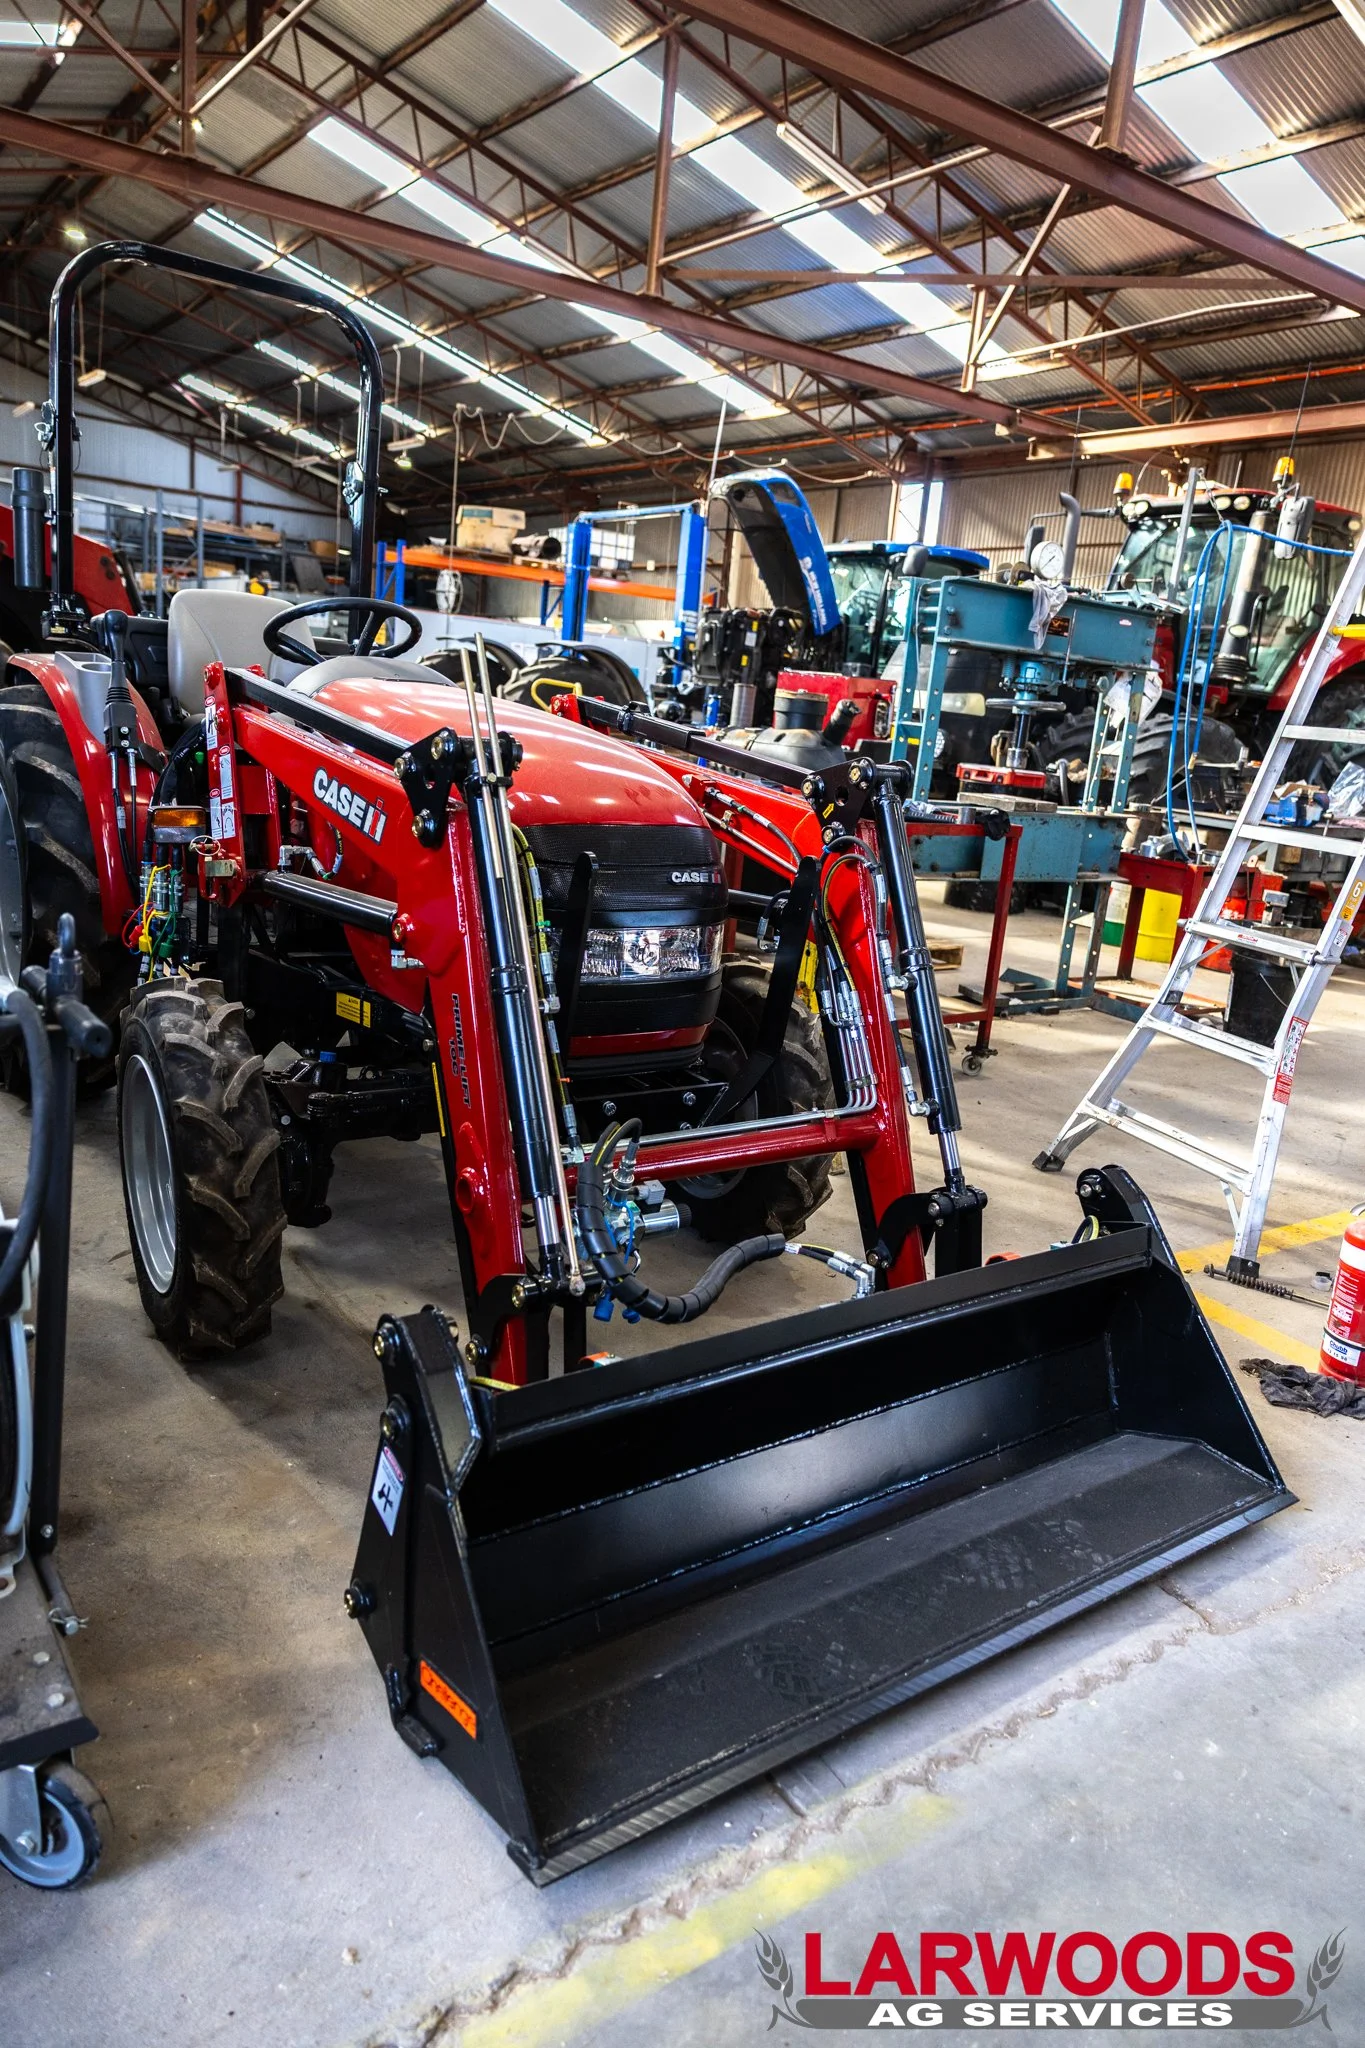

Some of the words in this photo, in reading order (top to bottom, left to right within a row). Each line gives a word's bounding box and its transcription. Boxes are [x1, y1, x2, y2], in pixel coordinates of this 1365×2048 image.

[313, 769, 367, 828] CASE
[671, 871, 709, 883] CASE
[1352, 881, 1363, 898] 6
[452, 993, 472, 1109] PRIME-LIFT
[1329, 1339, 1348, 1354] Chubb
